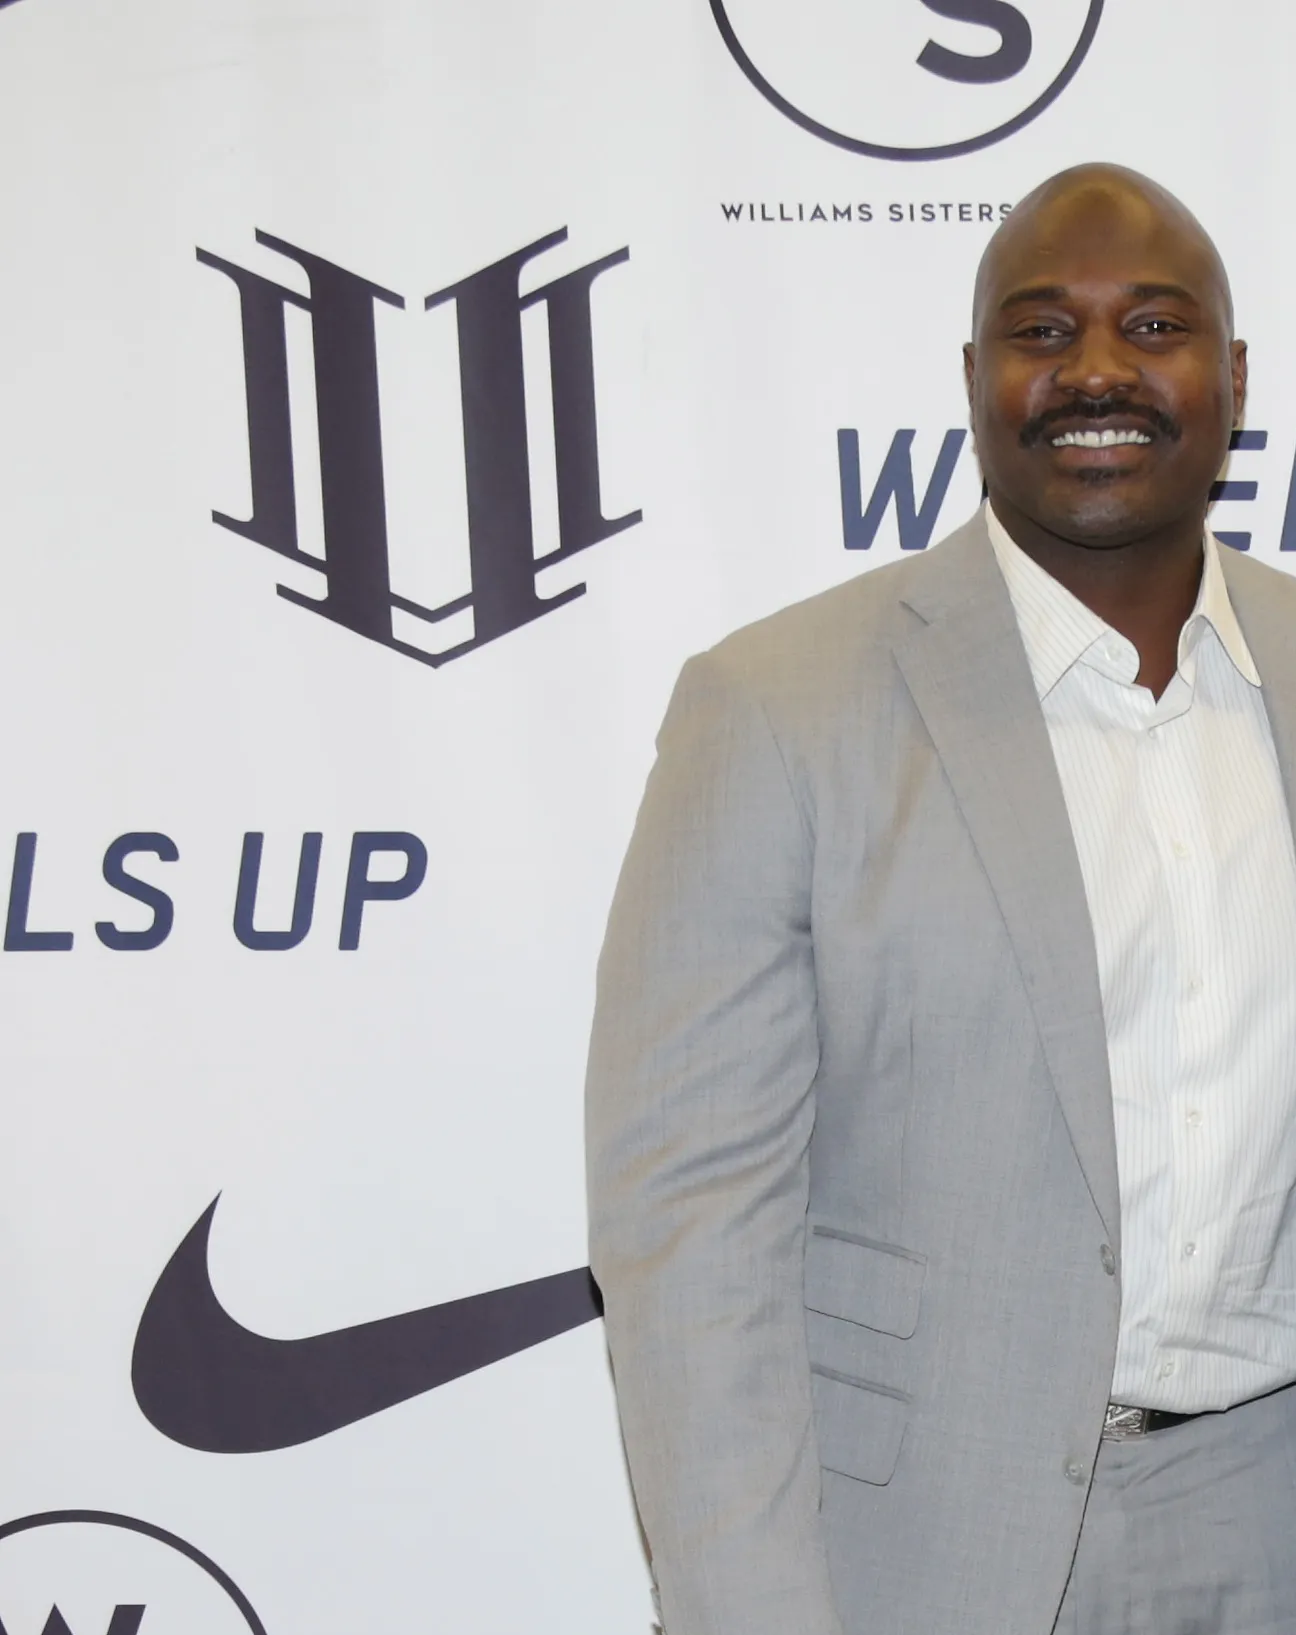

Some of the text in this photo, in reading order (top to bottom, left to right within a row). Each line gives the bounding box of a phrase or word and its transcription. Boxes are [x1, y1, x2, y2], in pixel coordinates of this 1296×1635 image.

[721, 203, 1013, 222] WILLIAMS SISTERS
[232, 832, 428, 951] UP
